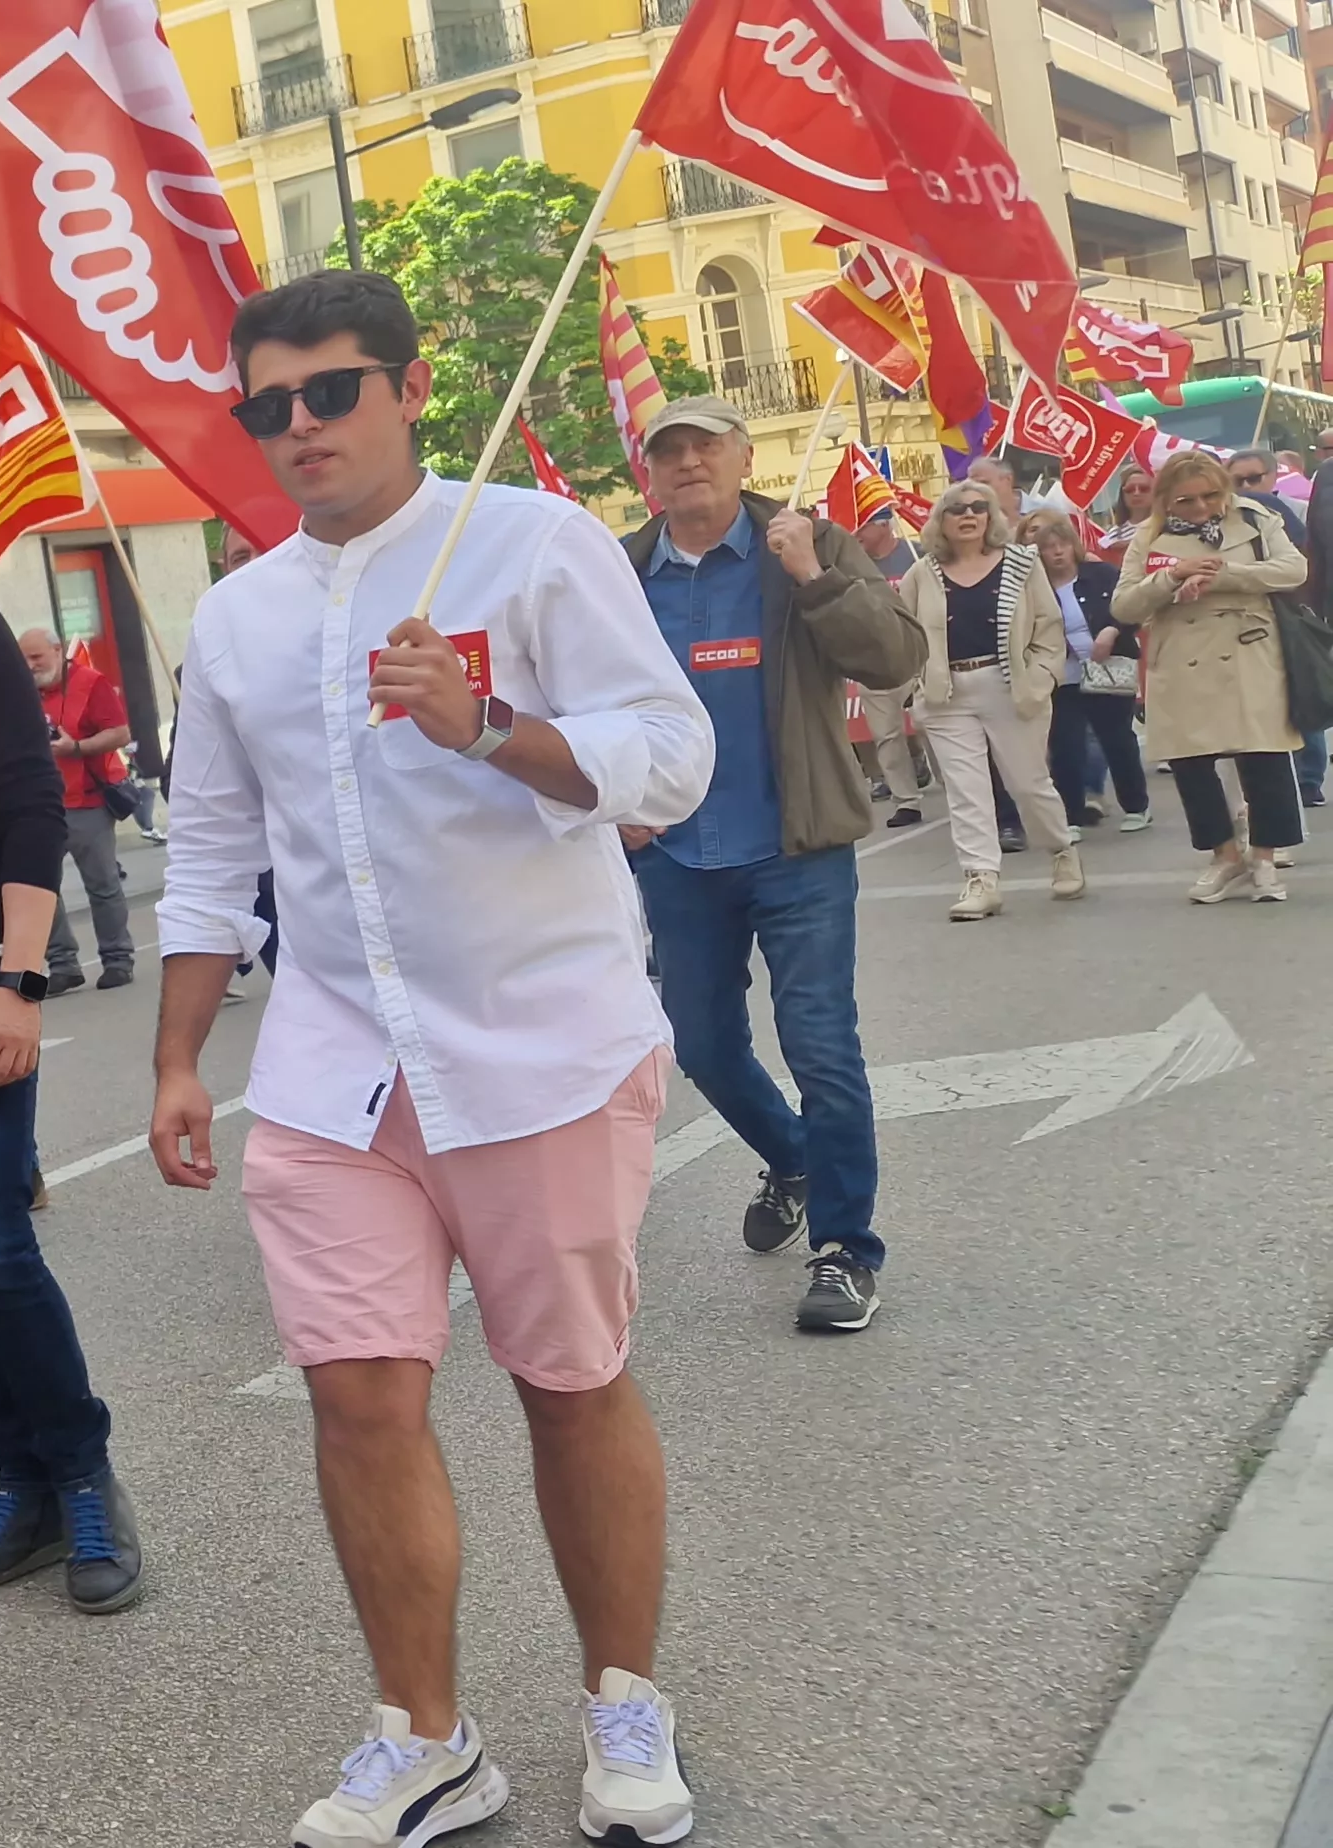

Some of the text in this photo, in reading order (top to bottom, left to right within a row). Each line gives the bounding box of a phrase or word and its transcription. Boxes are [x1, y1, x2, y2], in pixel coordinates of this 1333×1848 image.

[1032, 405, 1090, 455] UGT
[745, 473, 799, 491] kinte
[695, 648, 739, 663] CCOO
